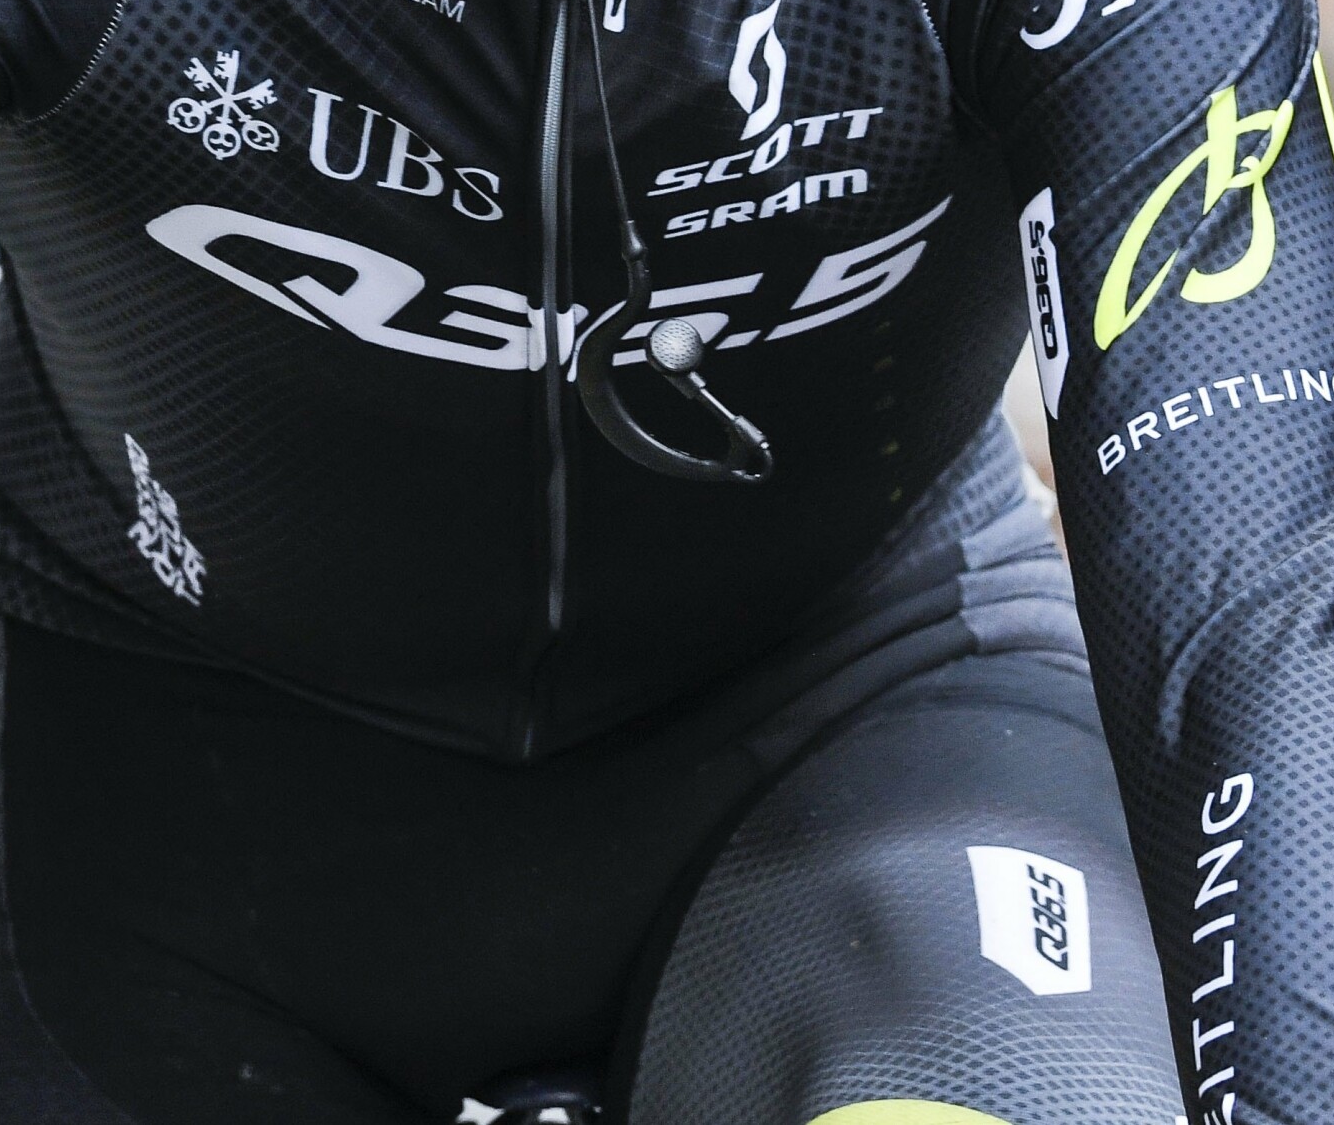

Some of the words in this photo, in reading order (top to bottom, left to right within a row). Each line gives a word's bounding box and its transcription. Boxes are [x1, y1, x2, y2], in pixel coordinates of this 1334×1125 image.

[306, 86, 504, 222] UBS
[647, 107, 884, 197] SCOTT
[664, 169, 868, 239] SRAM
[1028, 221, 1058, 360] Q36.5
[1027, 864, 1069, 971] Q36.5
